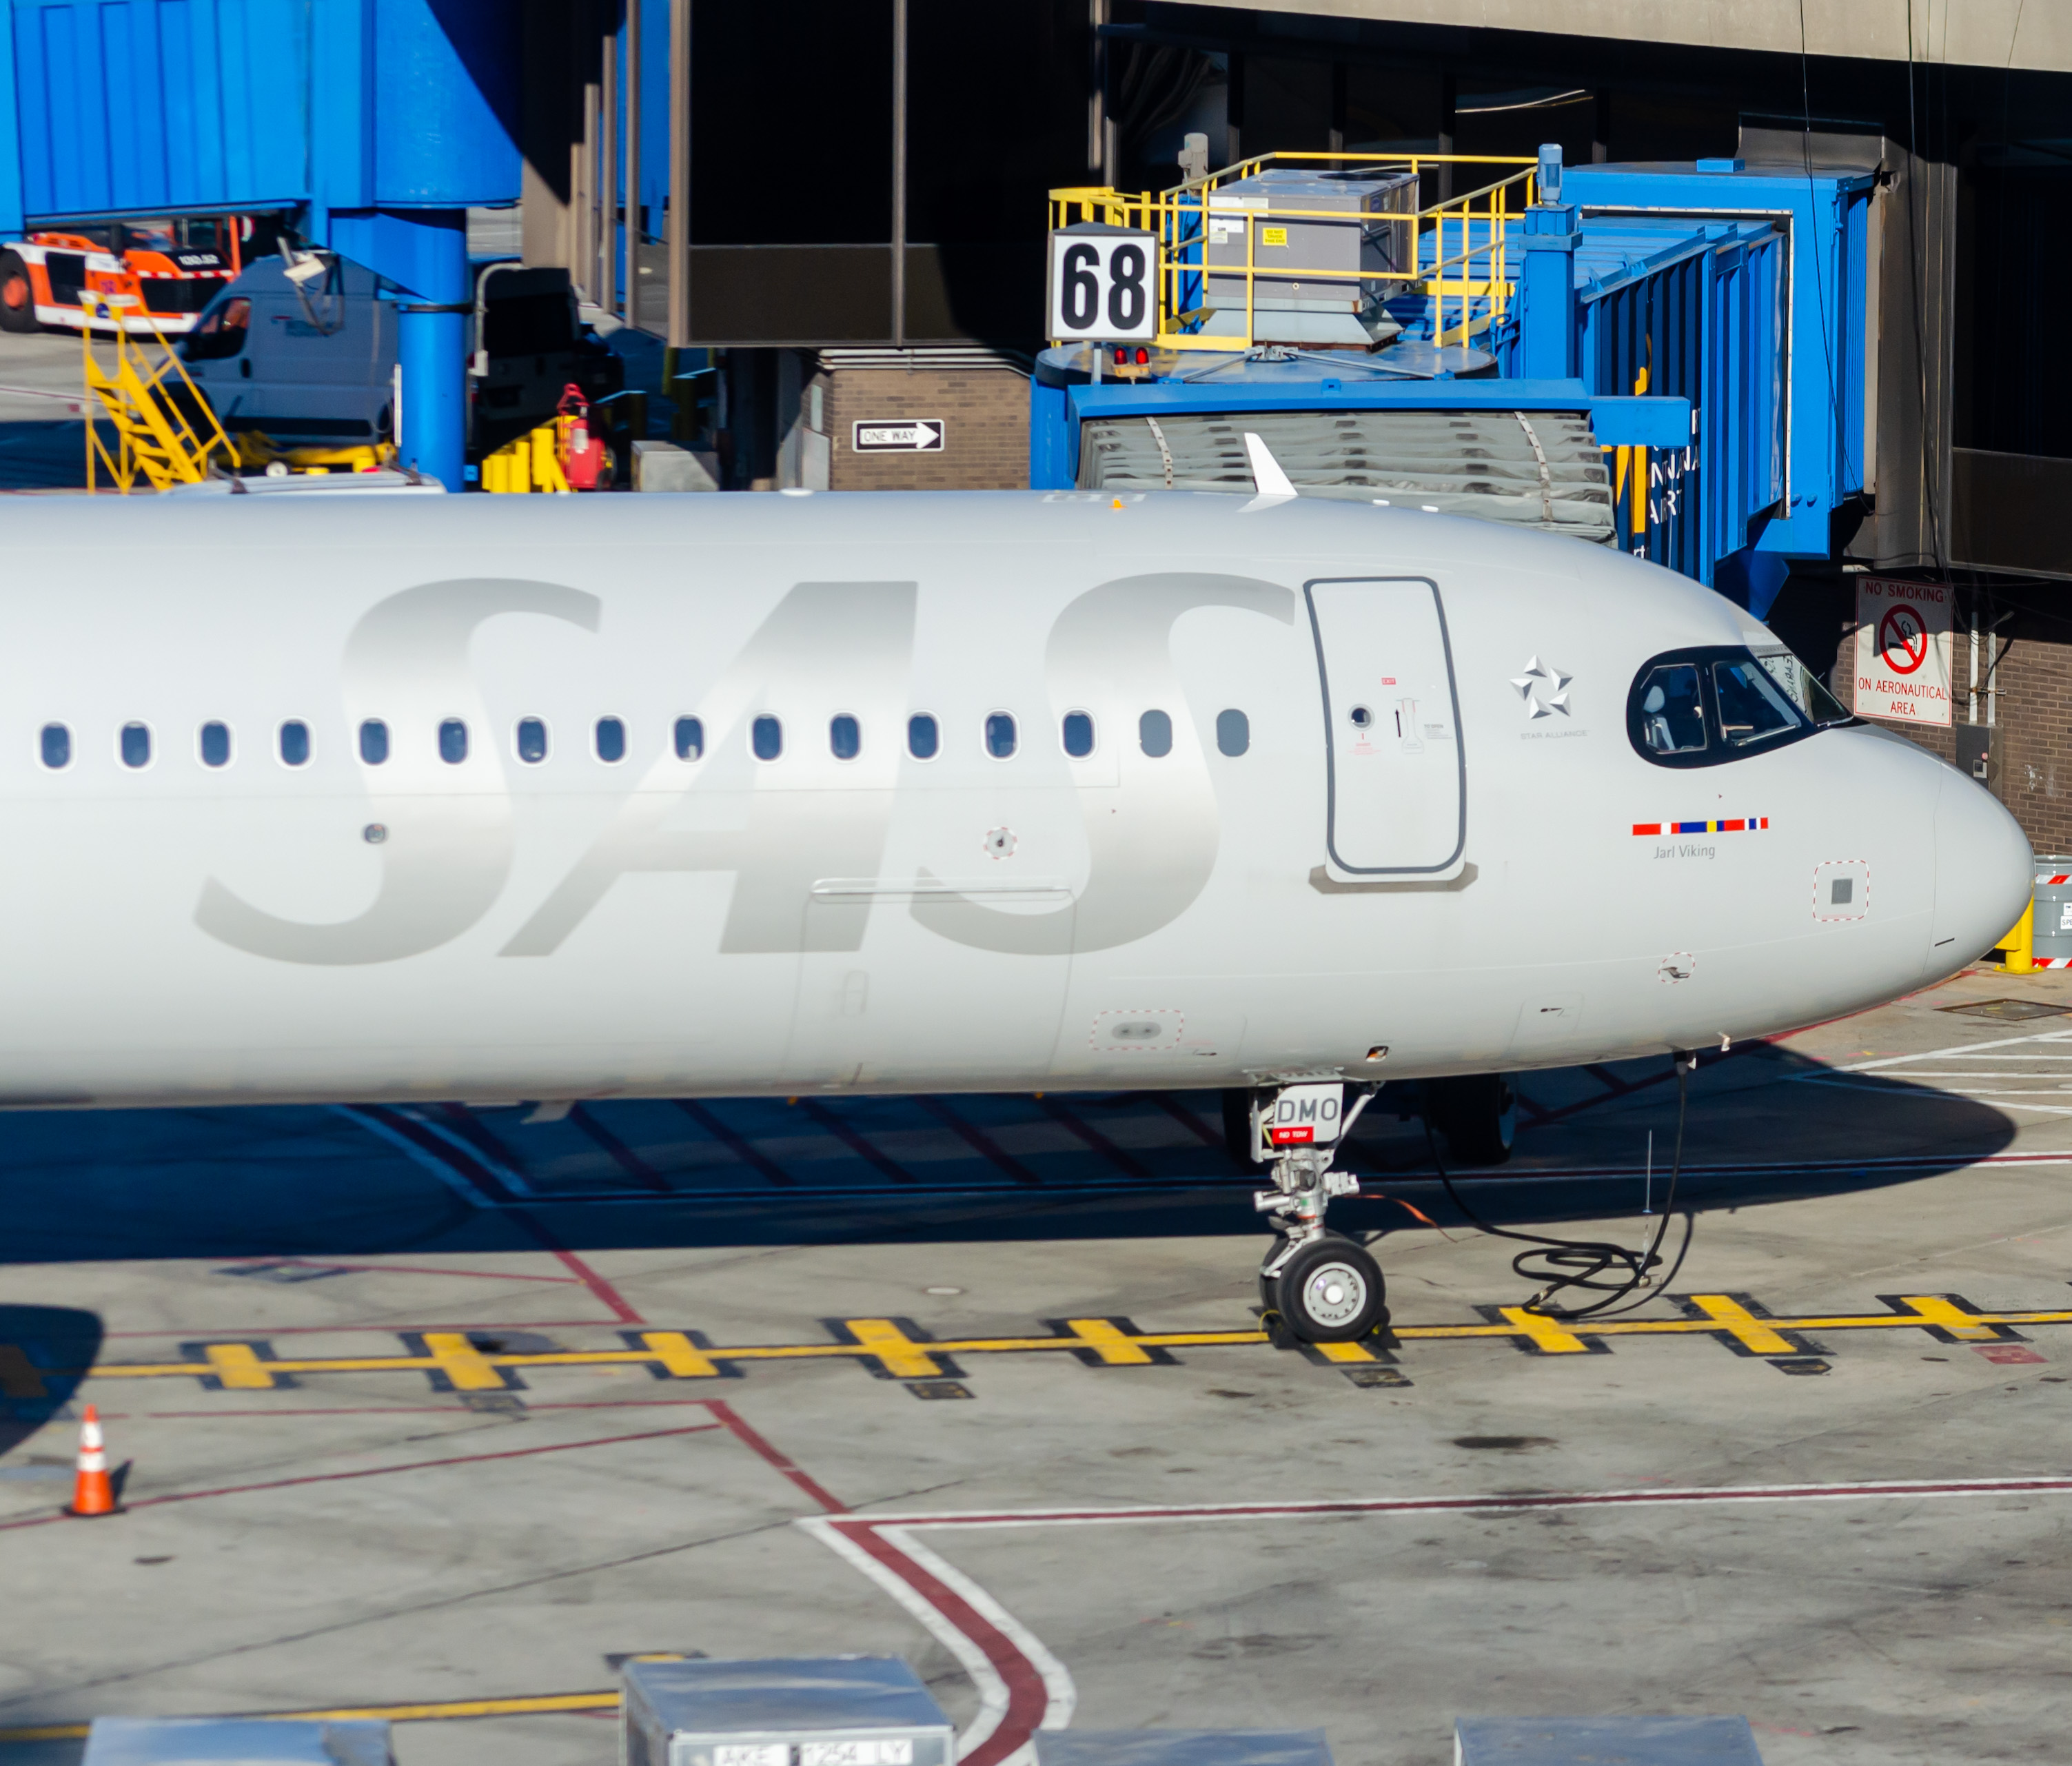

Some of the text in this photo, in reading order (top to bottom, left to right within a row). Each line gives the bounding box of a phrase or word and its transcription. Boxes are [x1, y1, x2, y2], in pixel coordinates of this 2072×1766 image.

[1062, 243, 1146, 330] 68
[864, 430, 915, 442] ONE WAY
[1865, 581, 1944, 603] NO SMOKING
[1858, 677, 1947, 700] ON AERONAUTICAL
[1890, 701, 1916, 715] AREA
[1545, 730, 1587, 738] ALLIANCE
[194, 571, 1294, 966] SAS
[1654, 844, 1716, 860] Jarl Viking
[1277, 1097, 1339, 1123] DMO
[1292, 1130, 1308, 1138] TOW
